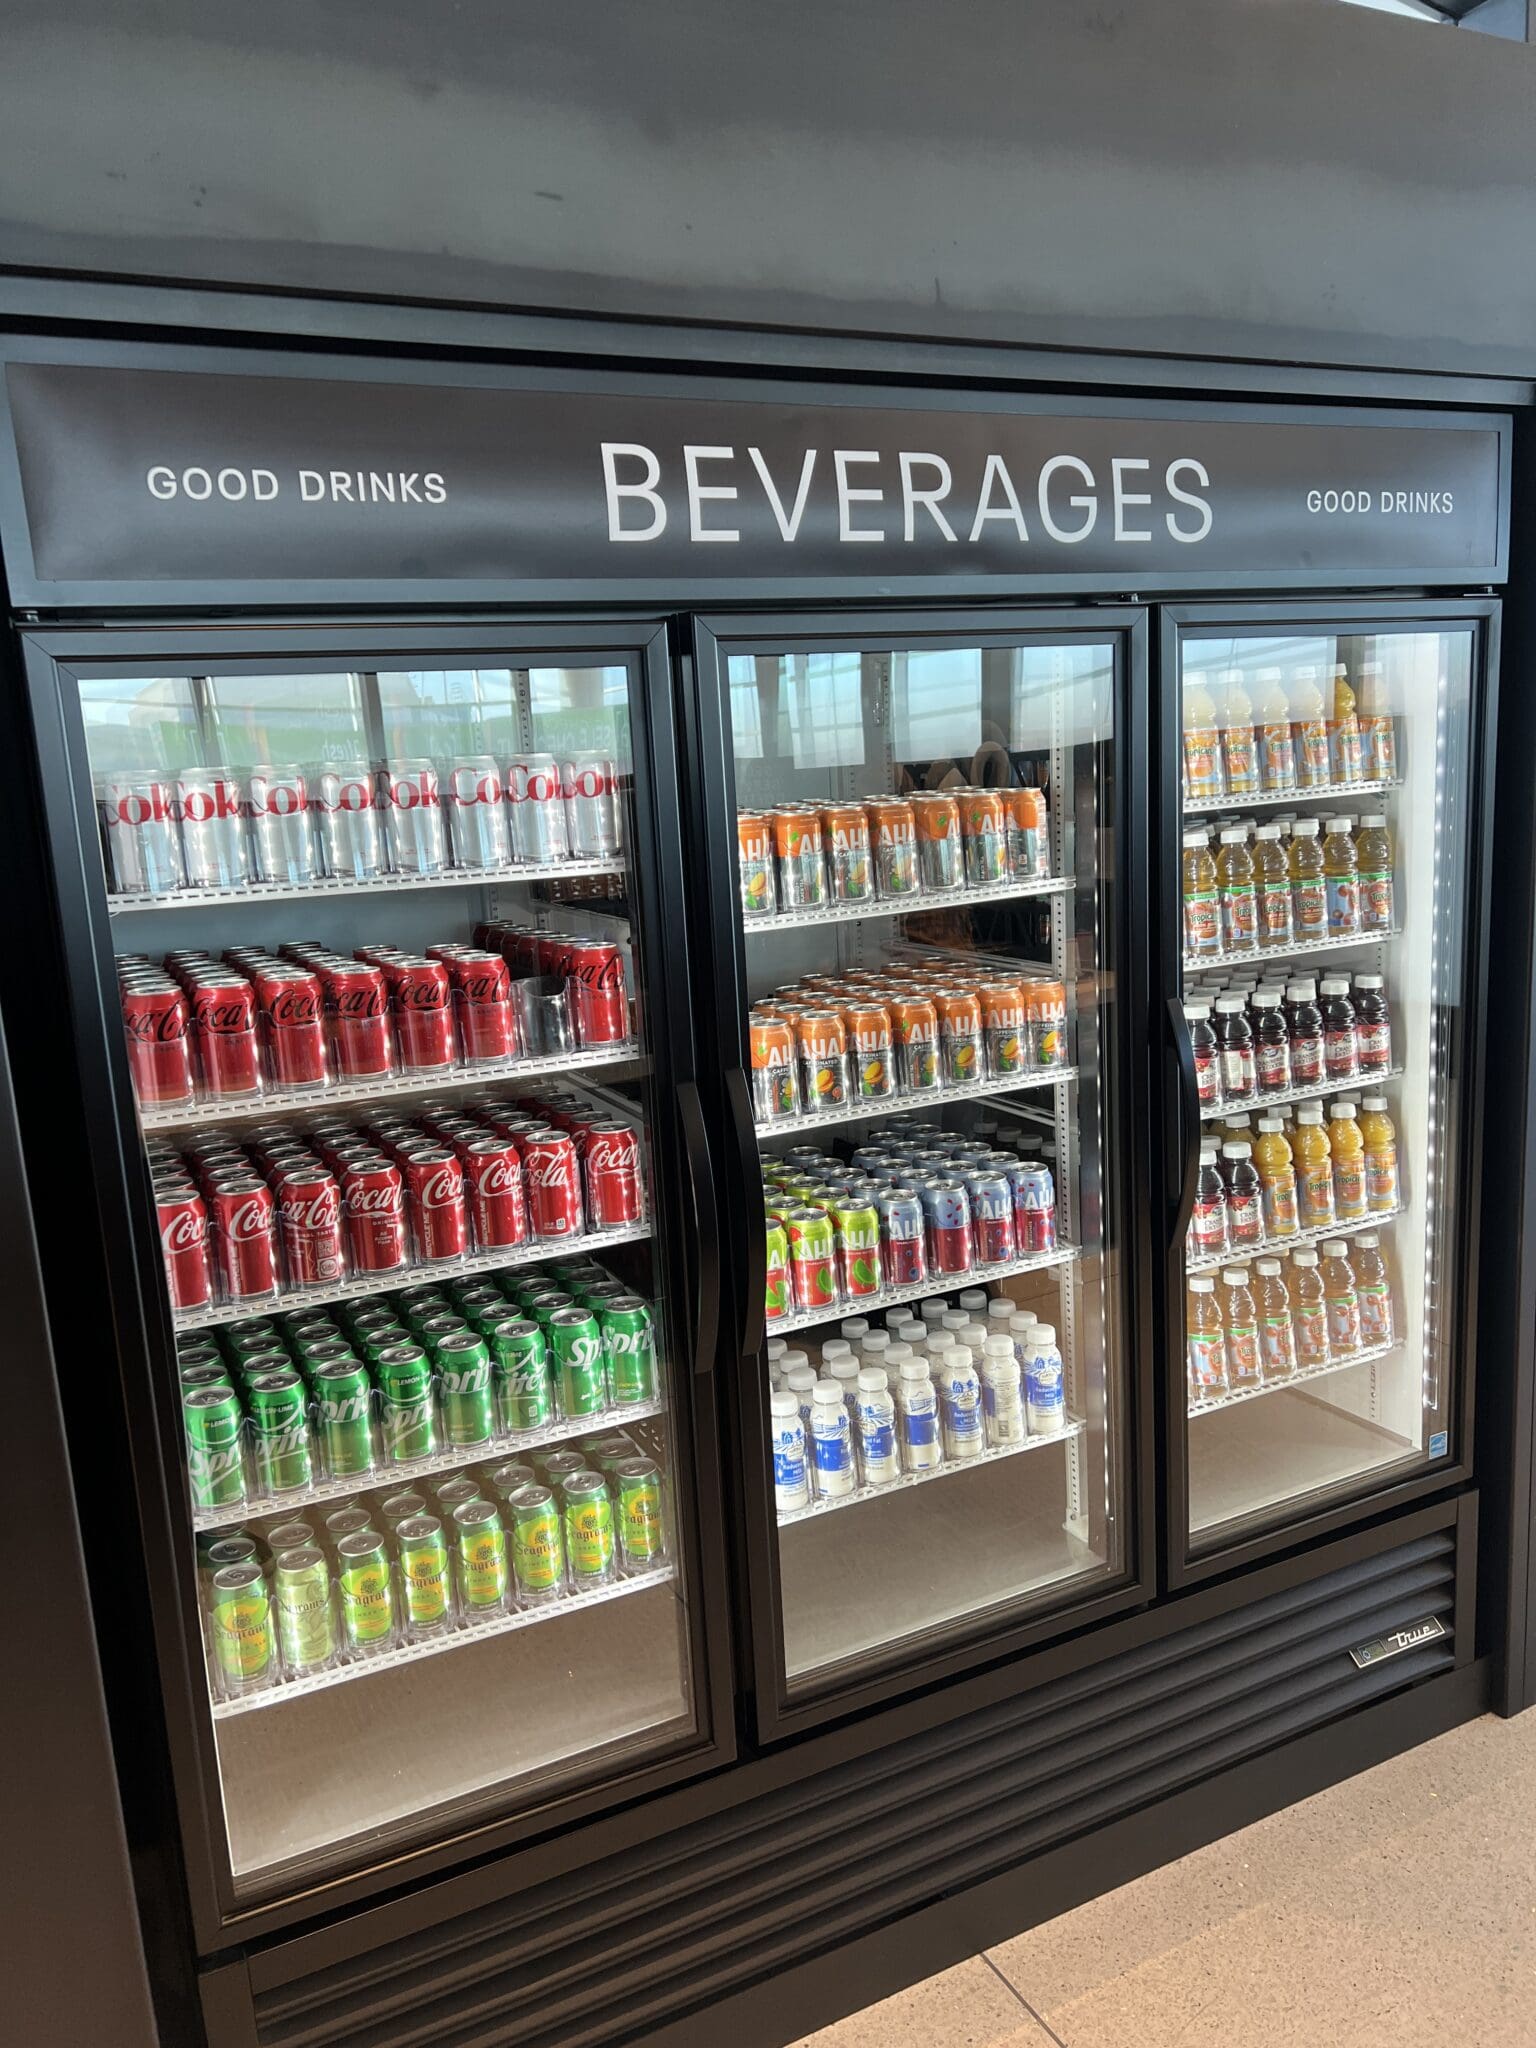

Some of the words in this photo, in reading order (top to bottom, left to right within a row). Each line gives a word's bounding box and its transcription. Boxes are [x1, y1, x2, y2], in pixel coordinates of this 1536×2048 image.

[147, 466, 279, 500] GOOD
[299, 470, 447, 504] DRINKS
[601, 442, 1214, 544] BEVERAGES
[1307, 489, 1372, 514] GOOD
[1380, 490, 1455, 515] DRINKS
